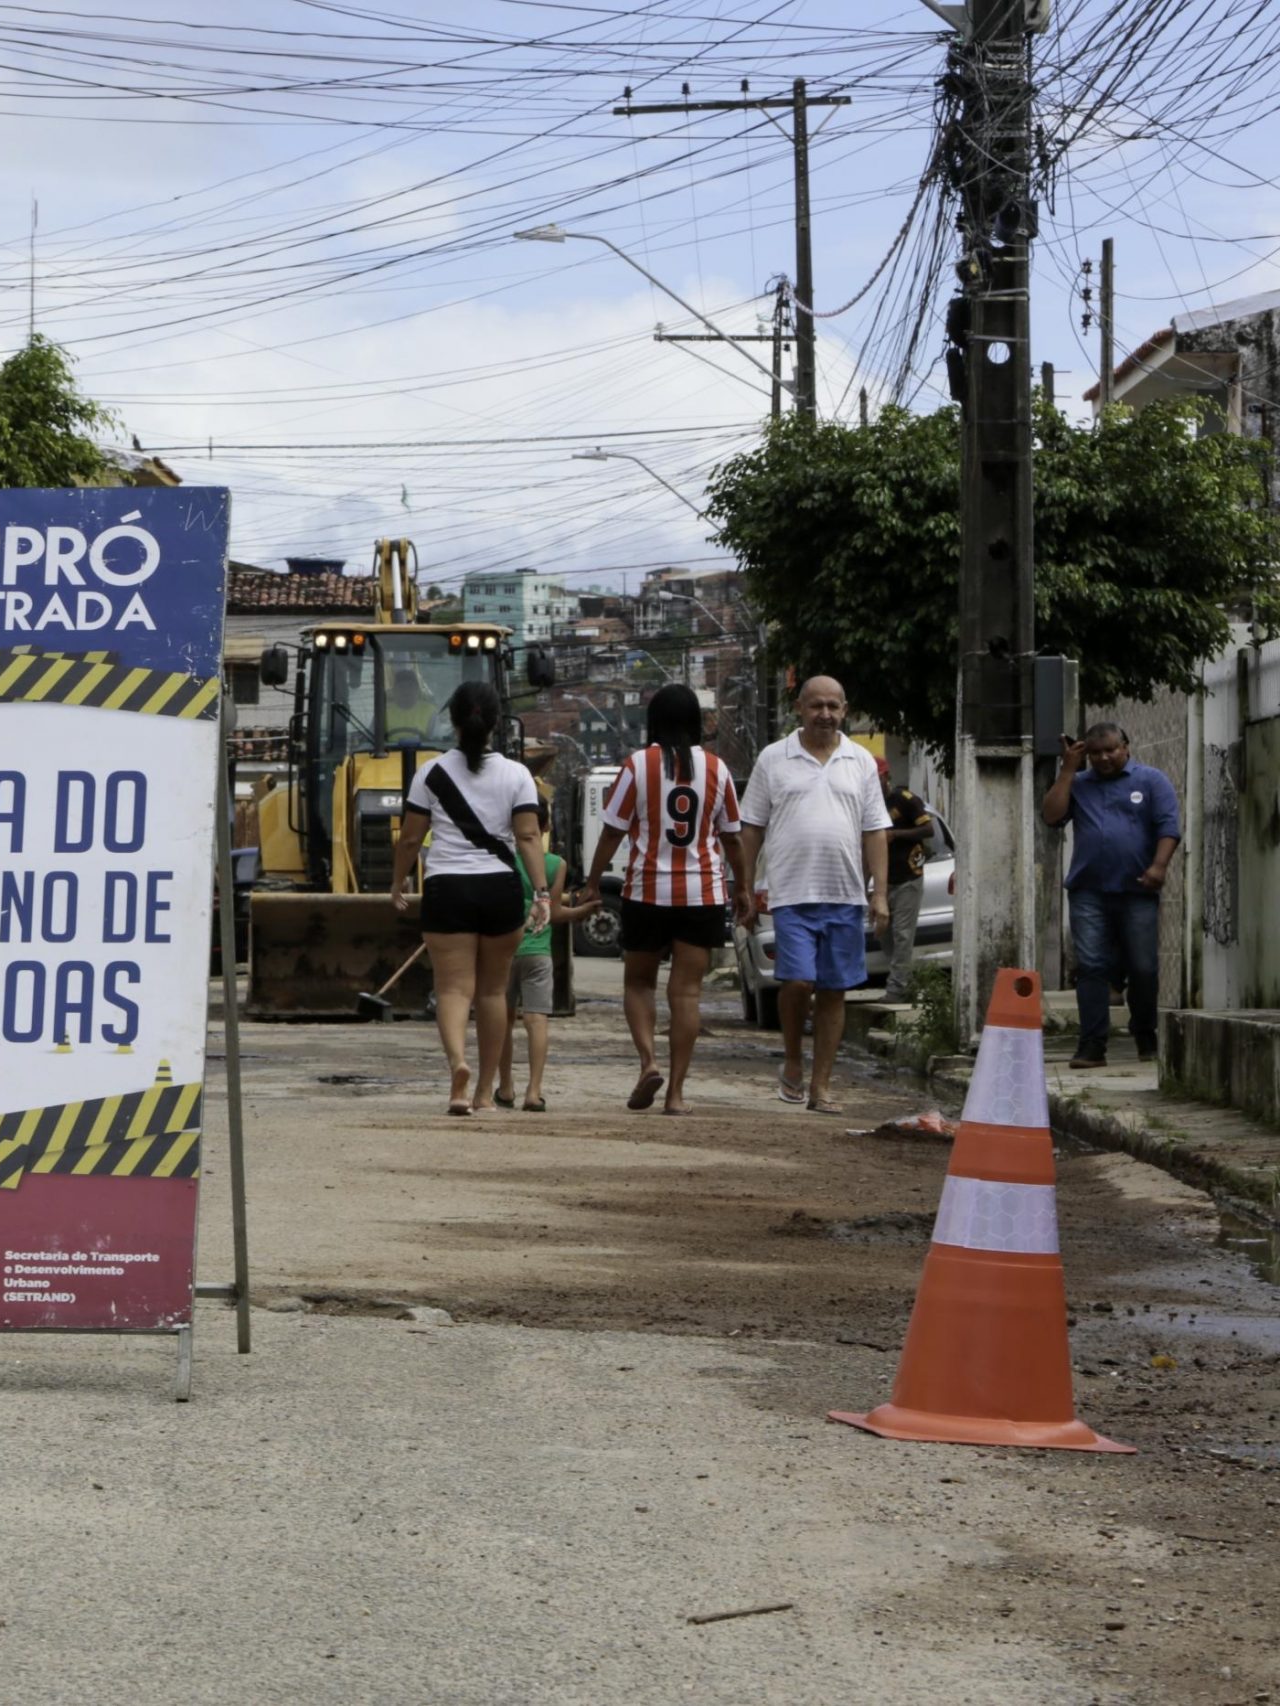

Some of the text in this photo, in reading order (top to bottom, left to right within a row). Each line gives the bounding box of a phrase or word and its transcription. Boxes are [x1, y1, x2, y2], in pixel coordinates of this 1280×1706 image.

[3, 509, 161, 587] PRÓ
[54, 770, 148, 853] DO
[665, 785, 699, 848] 9
[102, 870, 174, 943] DE
[4, 1250, 160, 1263] Secretaria de Transporte
[4, 1264, 124, 1276] e Desenvolvimento
[2, 1291, 76, 1304] (SETRAND)
[3, 1277, 50, 1288] Urbano
